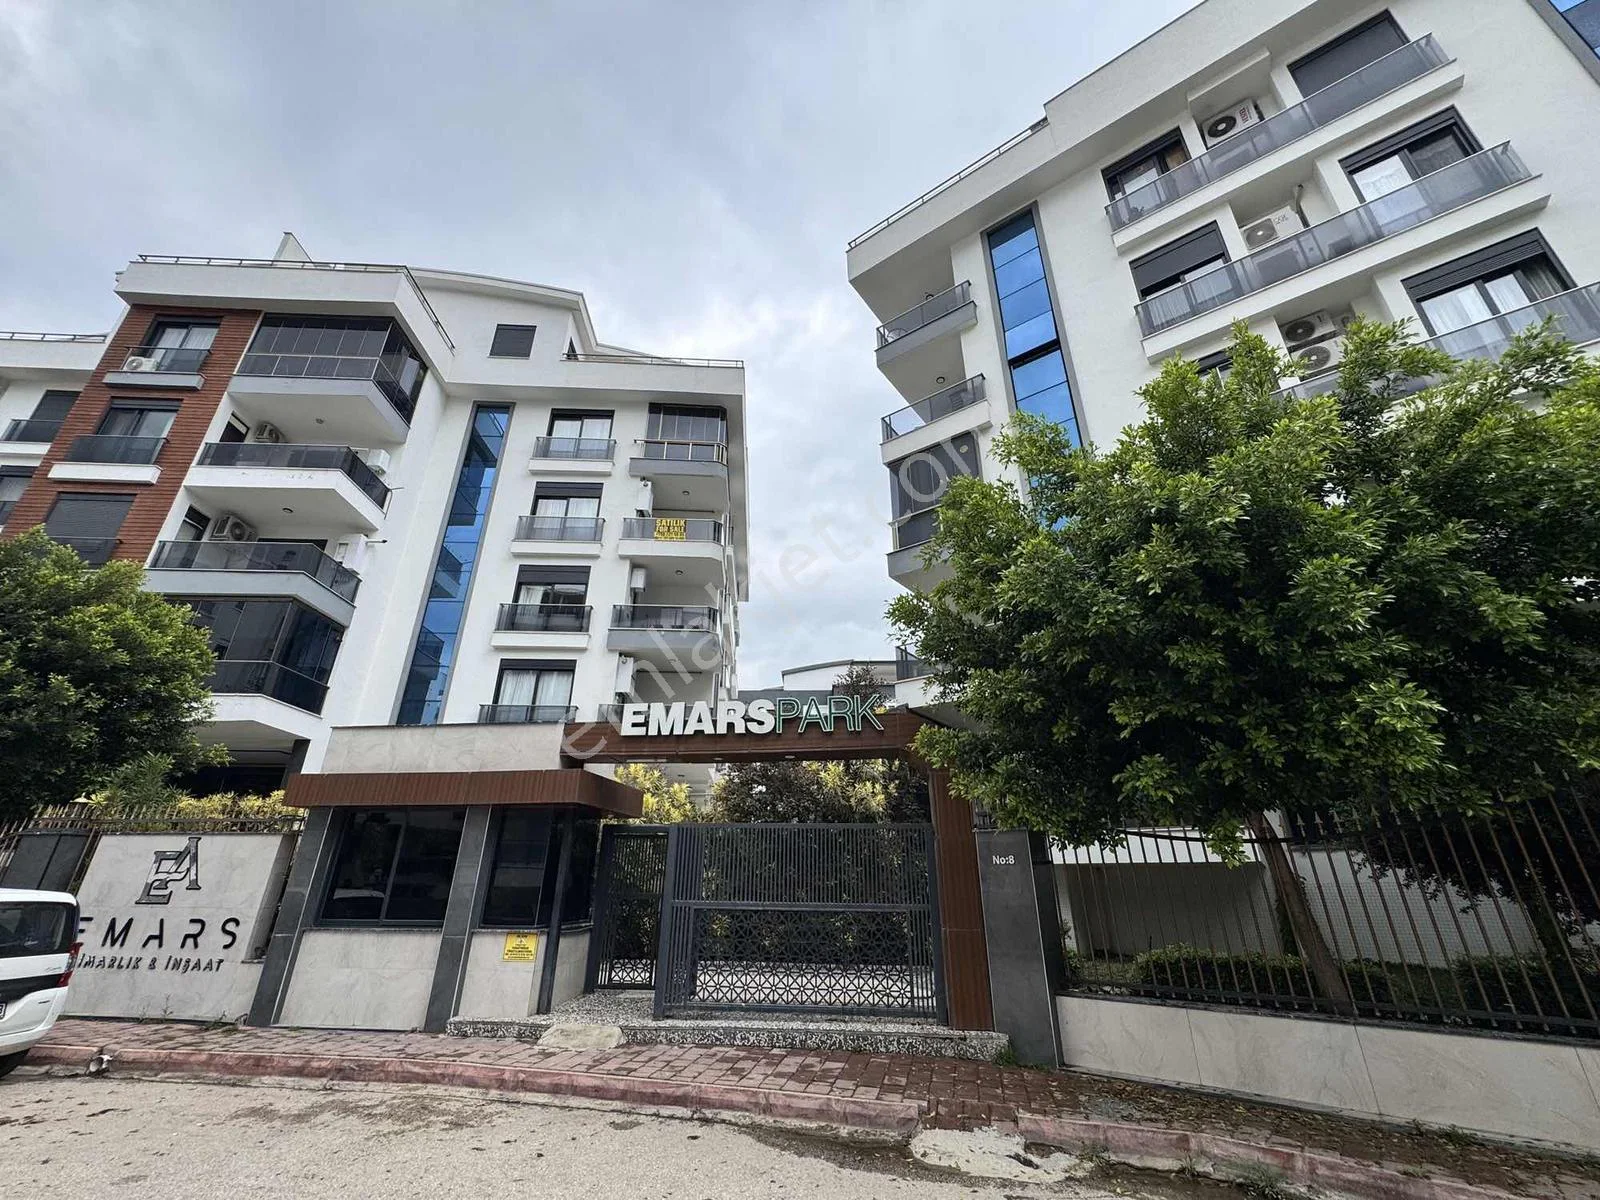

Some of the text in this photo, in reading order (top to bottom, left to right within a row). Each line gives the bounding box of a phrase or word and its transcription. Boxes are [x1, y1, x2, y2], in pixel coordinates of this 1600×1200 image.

[656, 519, 686, 527] SATILIK
[992, 854, 1015, 865] No:8
[148, 957, 158, 970] &
